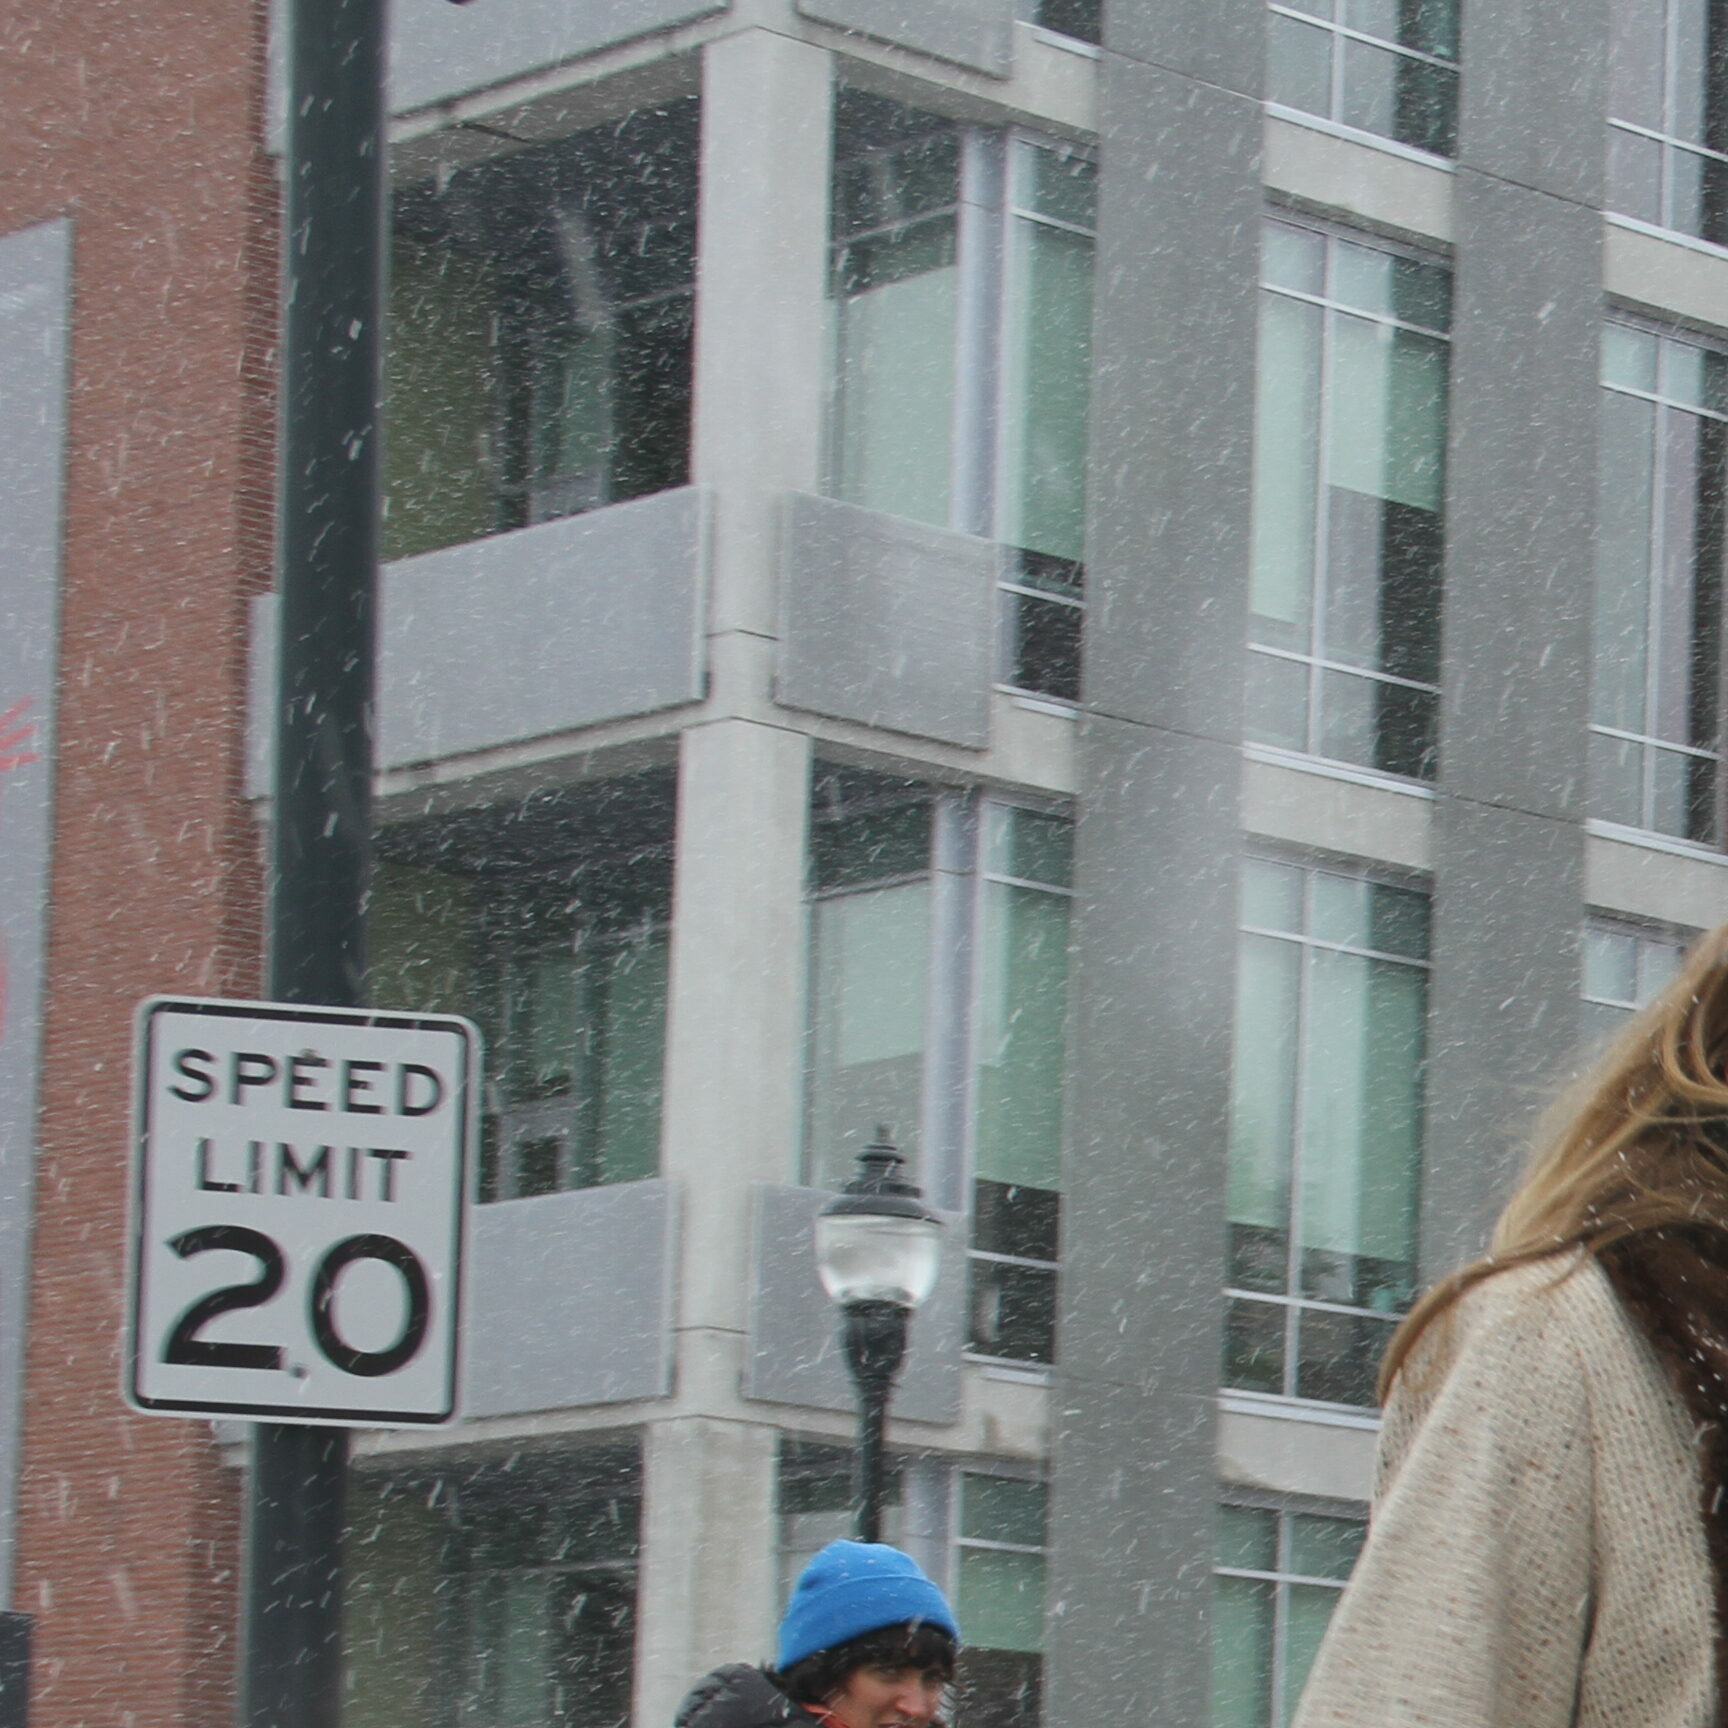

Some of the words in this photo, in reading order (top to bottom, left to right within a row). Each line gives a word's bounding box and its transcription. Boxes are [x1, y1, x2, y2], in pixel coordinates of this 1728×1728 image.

[168, 1049, 442, 1117] SPEED
[197, 1138, 412, 1202] LIMIT
[162, 1225, 430, 1377] 20
